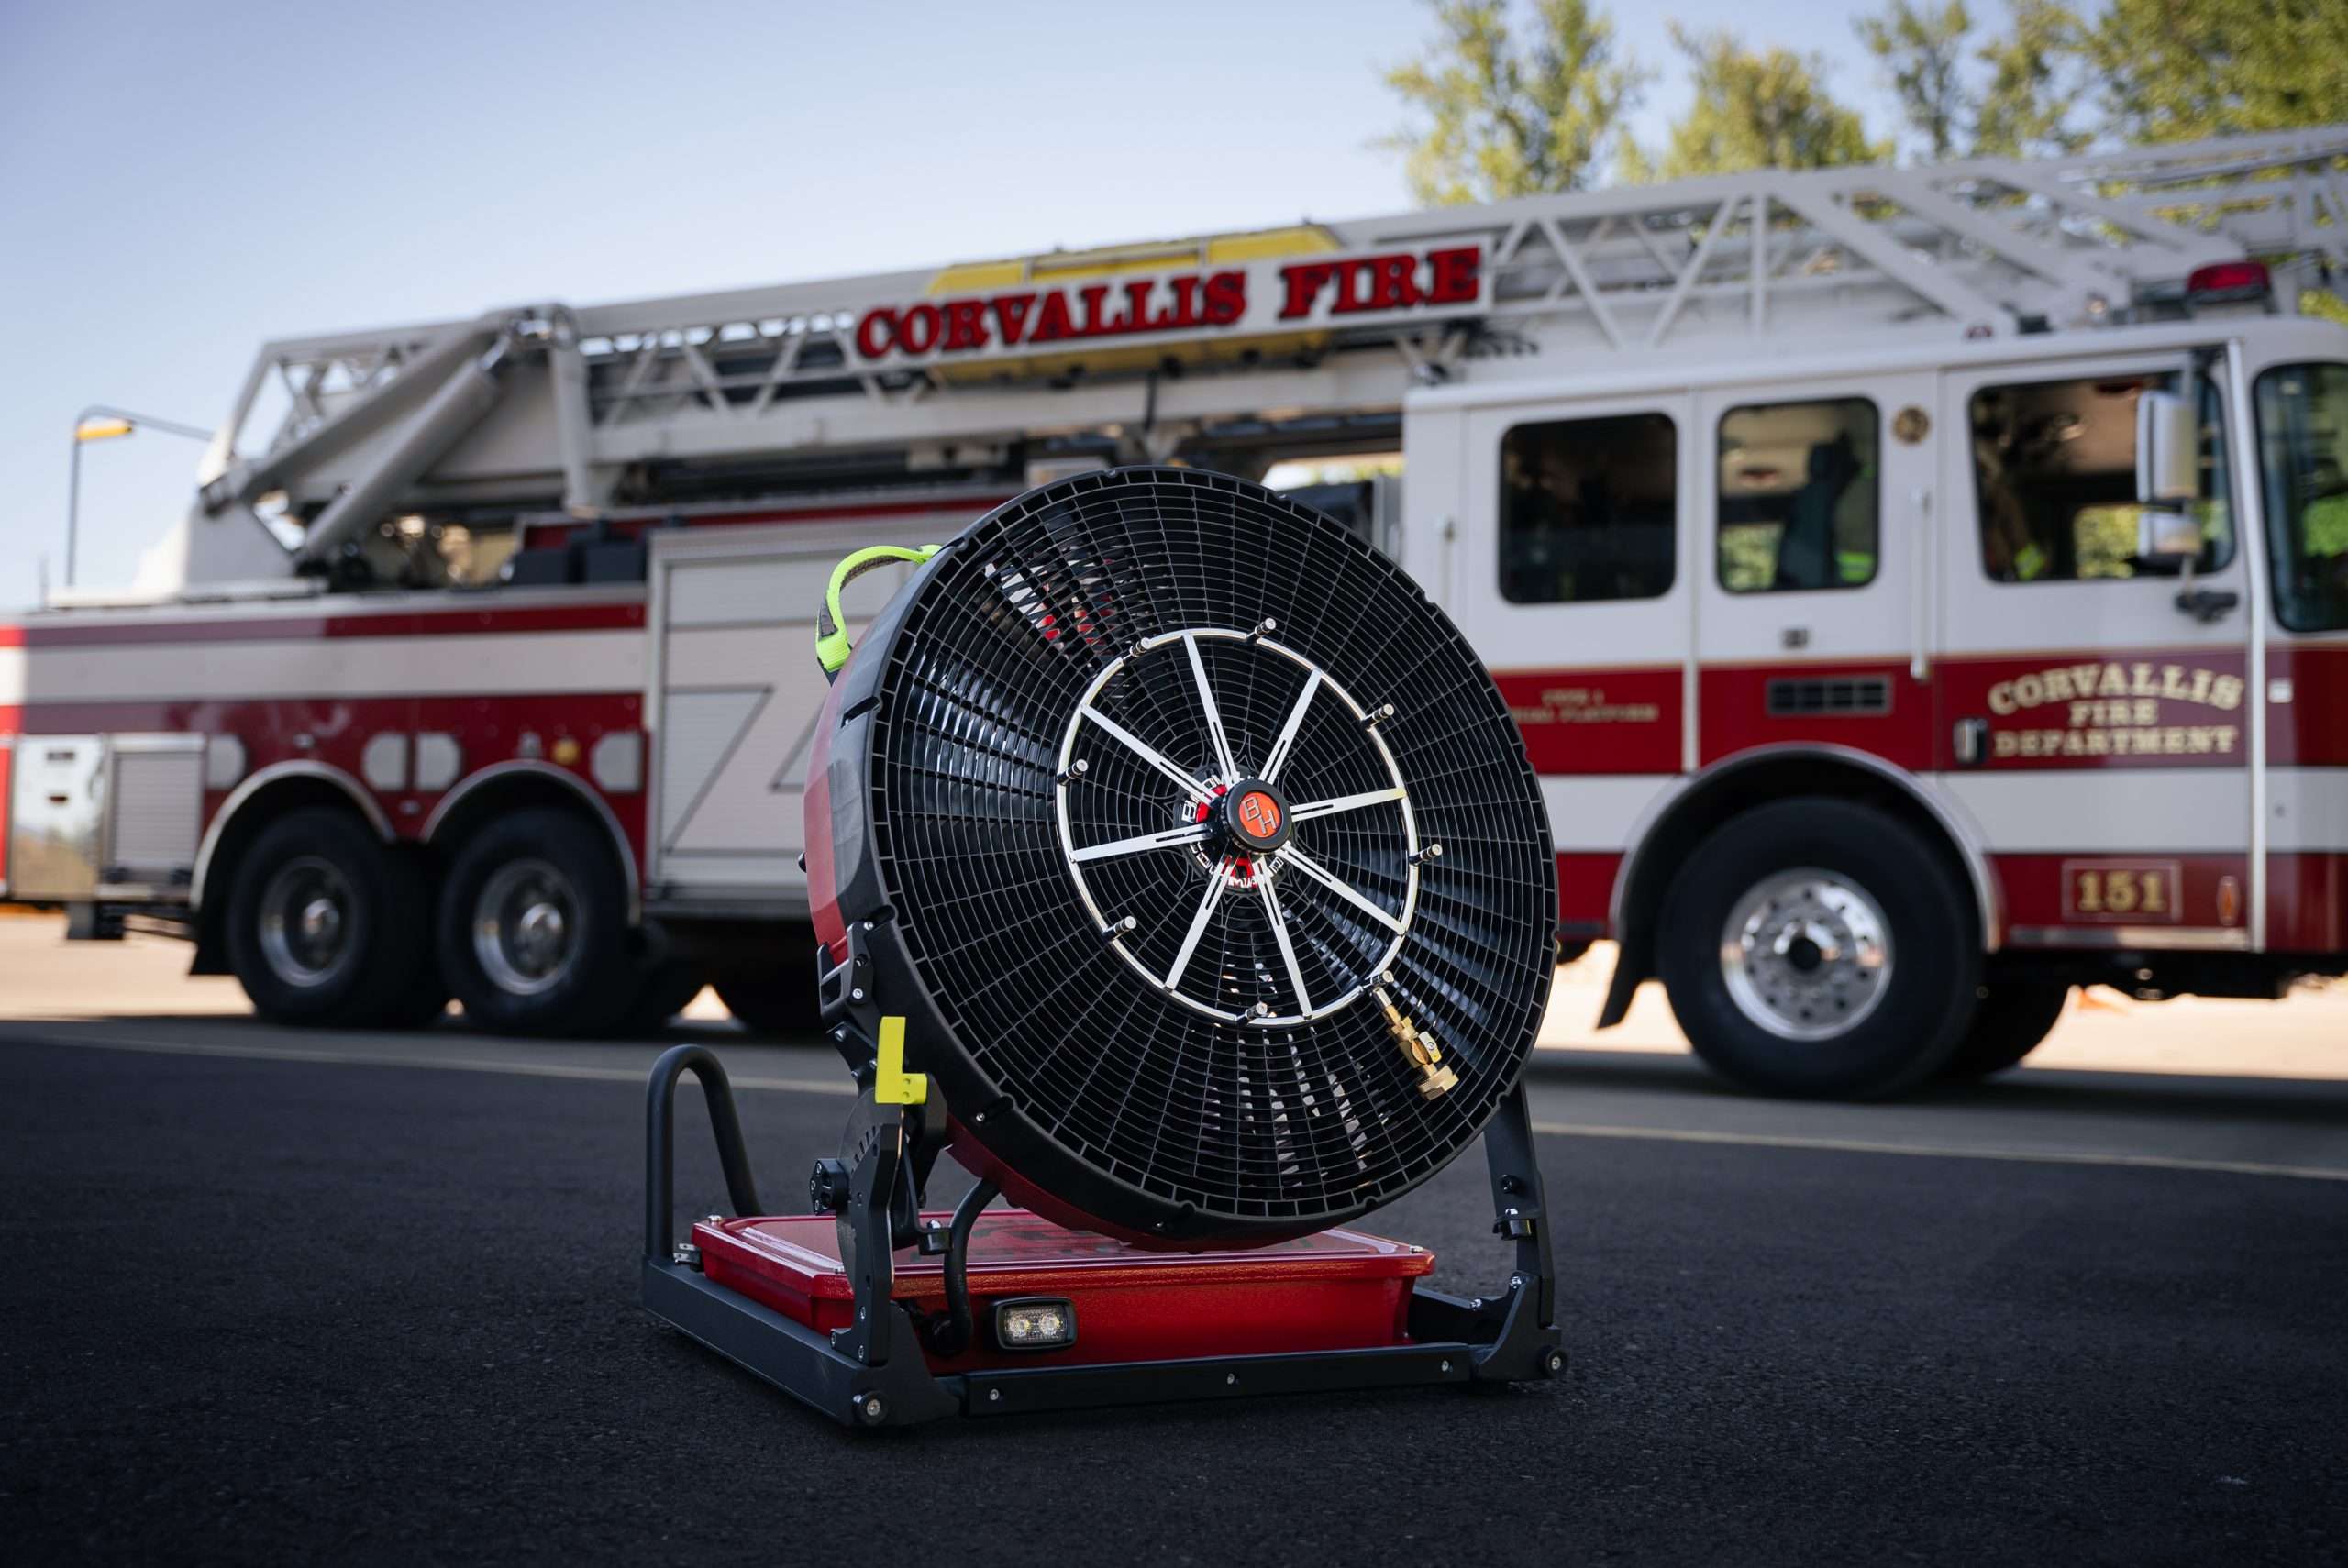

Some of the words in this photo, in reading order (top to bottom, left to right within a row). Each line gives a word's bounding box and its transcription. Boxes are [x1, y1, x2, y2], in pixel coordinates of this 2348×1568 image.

[856, 269, 1247, 359] CORVALLIS
[1279, 246, 1481, 321] FIRE
[1988, 663, 2244, 715] CORVALLIS
[2069, 699, 2158, 727] FIRE
[1993, 725, 2238, 756] DEPARTMENT
[2078, 872, 2165, 912] 151
